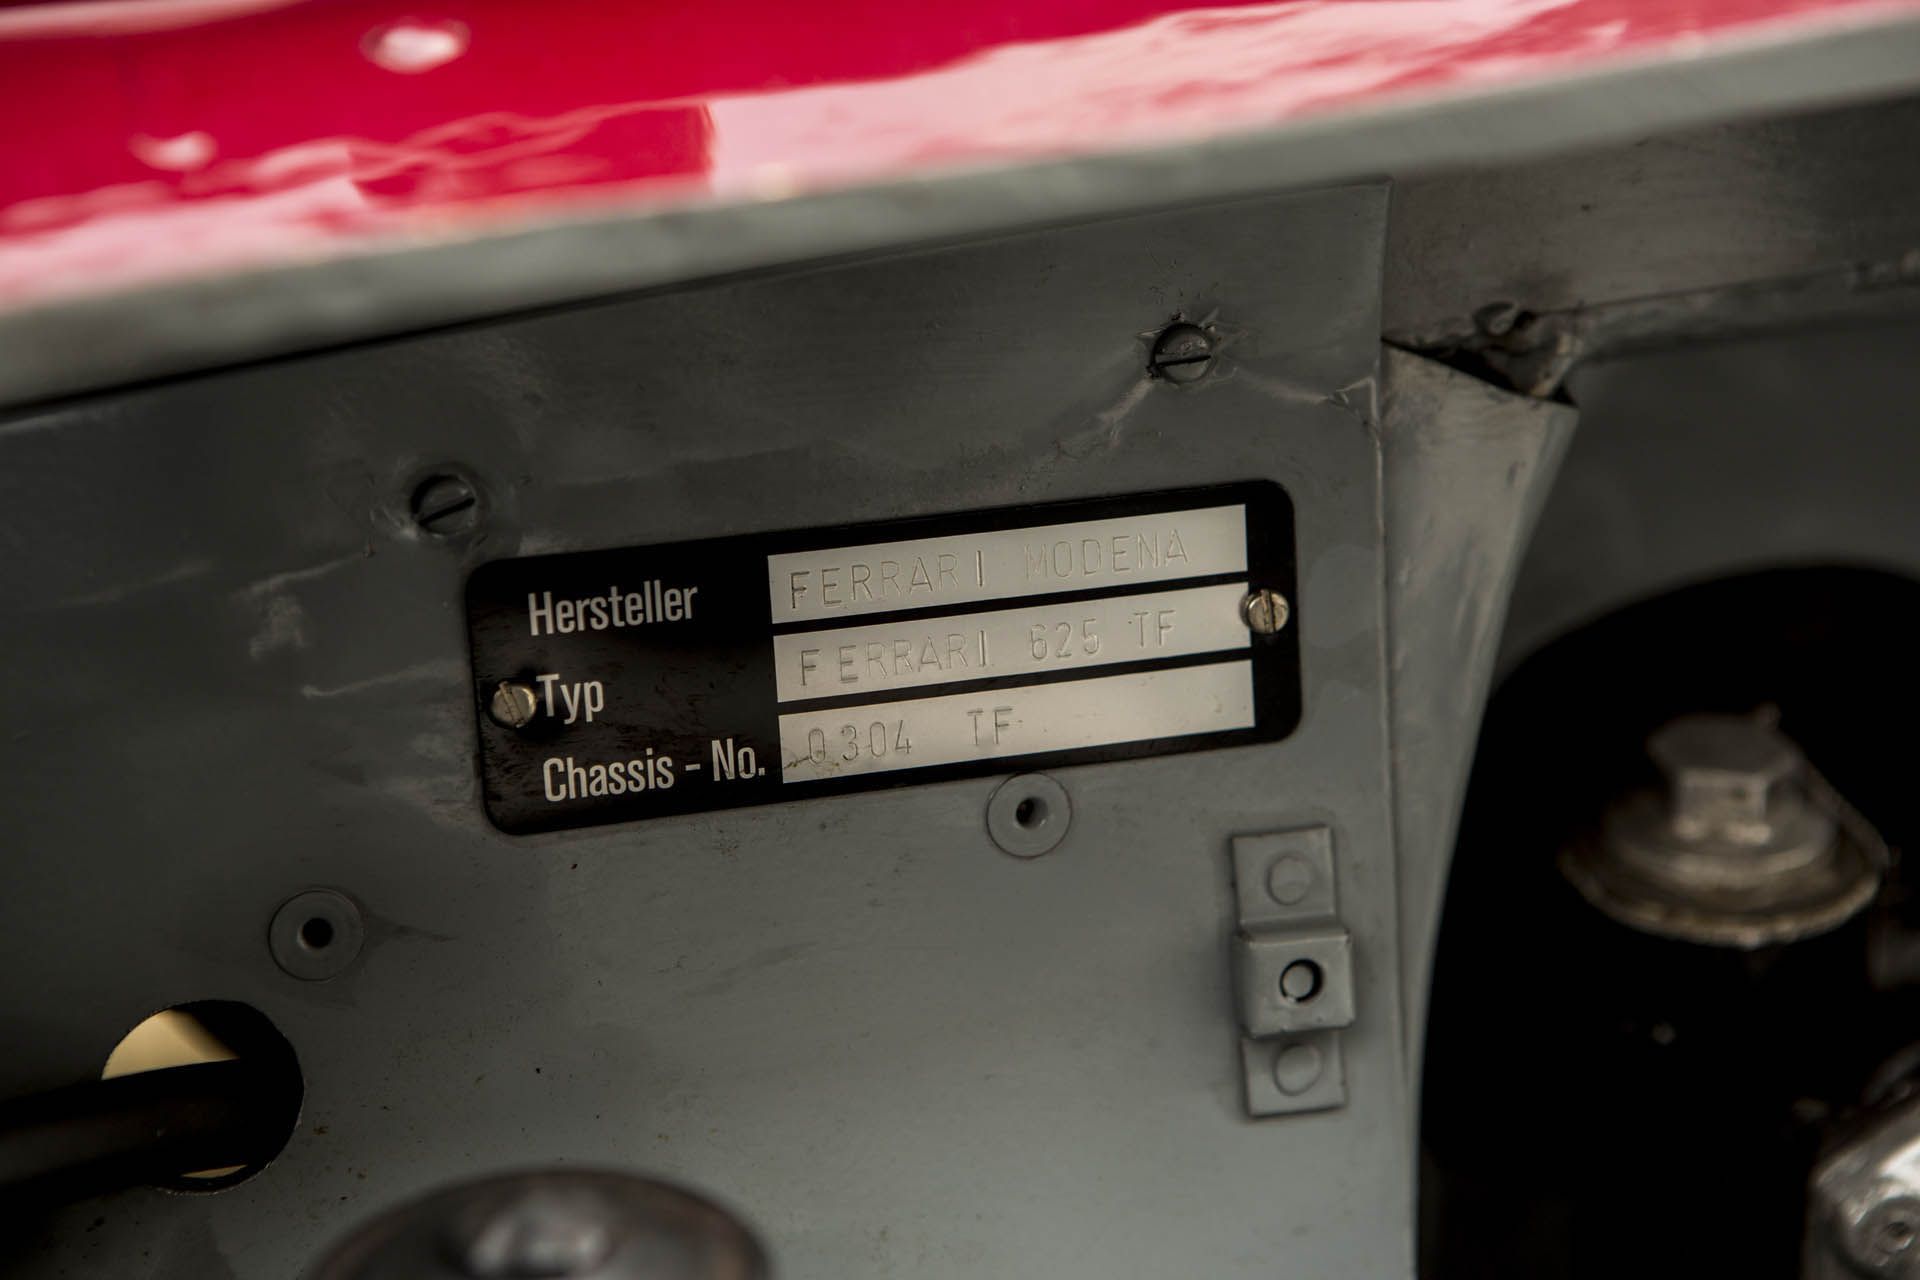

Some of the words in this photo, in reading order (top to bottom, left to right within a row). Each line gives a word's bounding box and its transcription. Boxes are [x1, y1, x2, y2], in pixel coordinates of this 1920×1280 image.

[789, 549, 985, 610] FERRARI
[1024, 528, 1189, 582] MODENA
[527, 579, 699, 637] Hersteller
[800, 628, 990, 687] FERRARI
[1028, 616, 1101, 661] 625
[1132, 608, 1178, 650] TF
[536, 672, 605, 726] Typ
[807, 718, 913, 766] 0304
[966, 705, 1014, 747] TF
[541, 747, 675, 803] Chassis
[711, 737, 766, 782] No.
